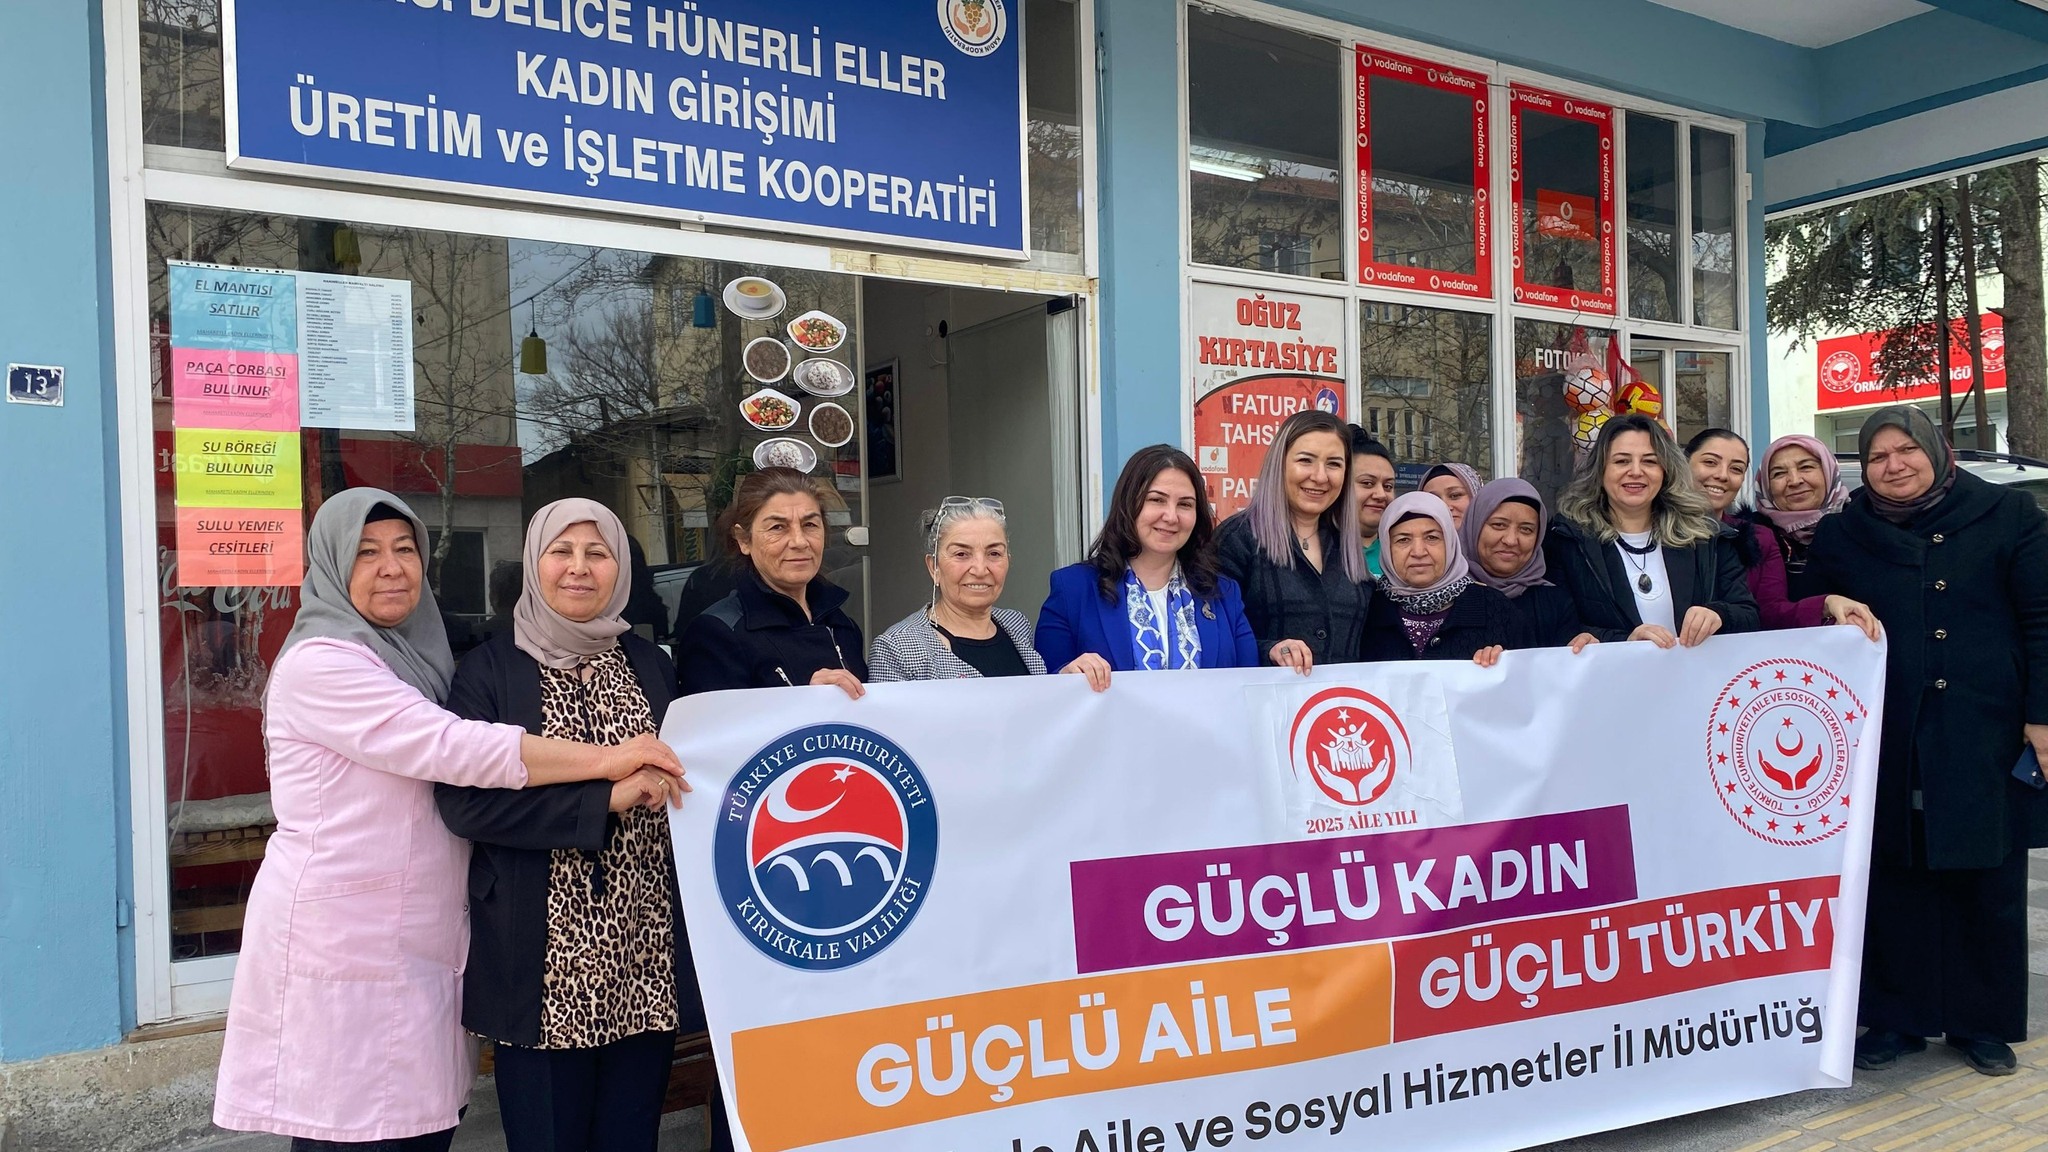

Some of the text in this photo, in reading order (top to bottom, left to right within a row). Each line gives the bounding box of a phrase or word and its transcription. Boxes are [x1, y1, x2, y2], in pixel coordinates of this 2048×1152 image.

[647, 1, 822, 78] HÜNERLİ
[836, 42, 947, 101] ELLER
[1374, 57, 1413, 75] vodafone
[517, 51, 836, 146] KADIN GİRİŞİMİ
[1519, 93, 1552, 108] vodafone
[1575, 105, 1607, 120] vodafone
[289, 74, 997, 229] ÜRETİM ve İŞLETME KOOPERATİFİ
[1377, 271, 1415, 284] vodafone
[1442, 280, 1478, 292] vodafone
[195, 280, 273, 295] EL MANTISI
[1525, 290, 1558, 303] vodafone
[209, 303, 260, 317] SATILIR
[1236, 293, 1302, 330] OĞUZ
[1581, 299, 1612, 311] vodafone
[1199, 336, 1338, 373] KIRTASİYE
[186, 361, 223, 375] PAÇA
[24, 372, 48, 395] 13
[203, 383, 271, 397] BULUNUR
[1232, 393, 1310, 416] FATURA
[202, 440, 277, 454] SU BÖREĞİ
[206, 462, 274, 474] BULUNUR
[1200, 465, 1227, 473] vodafone
[197, 520, 284, 532] SULU YEMEK
[209, 540, 274, 554] ÇEŞİTLERİ
[1735, 692, 1846, 811] TÜRKİYE CUMHURİYETİ AİLE VE SOSYAL HİZMETLER BAKANLIĞI
[728, 733, 927, 822] TÜRKİYE CUMHURİYETİ
[1306, 809, 1418, 834] 2025 AİLE YILI
[1144, 839, 1589, 947] GÜÇLÜ KADIN
[737, 877, 922, 960] KIRIKKALE VALİLİĞİ
[1420, 917, 1620, 1009] GÜÇLÜ
[856, 980, 1297, 1109] GÜÇLÜ AİLE
[1074, 997, 1826, 1152] Aile ve Sosyal Hizmetler İl Müdürlüğ
